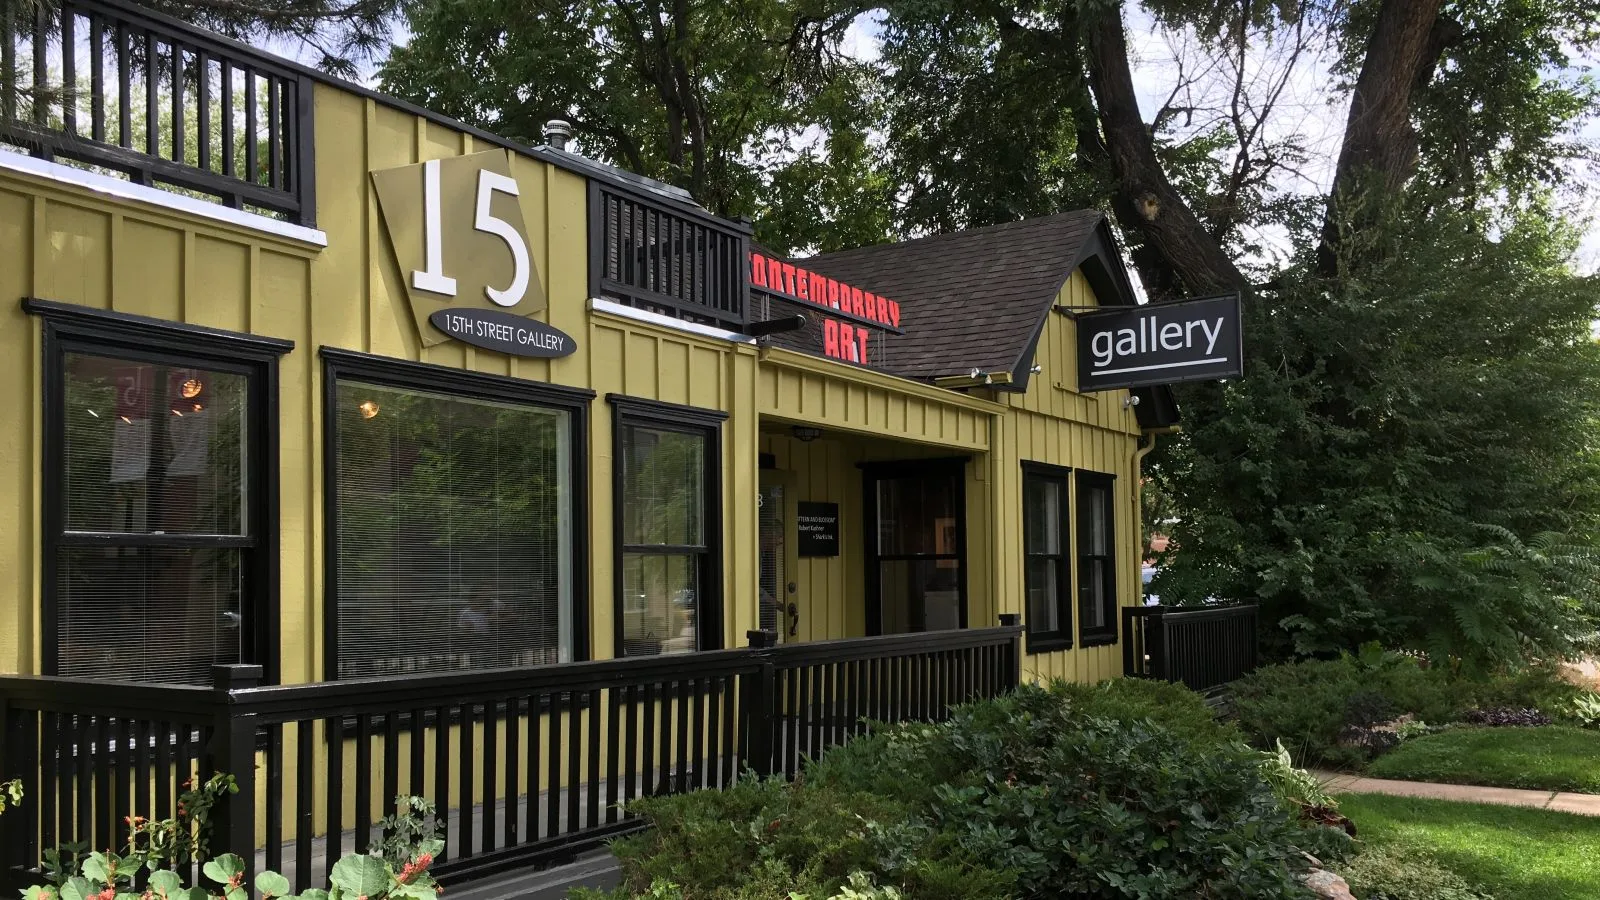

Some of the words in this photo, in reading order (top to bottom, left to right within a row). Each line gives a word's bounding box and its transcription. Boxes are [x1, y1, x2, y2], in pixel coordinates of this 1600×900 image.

[412, 159, 530, 307] 15
[749, 252, 900, 328] ONTEMPORARY
[445, 314, 474, 335] 15TH
[476, 321, 514, 342] STREET
[517, 328, 564, 352] GALLERY
[824, 318, 869, 365] ART
[1091, 316, 1224, 367] gallery
